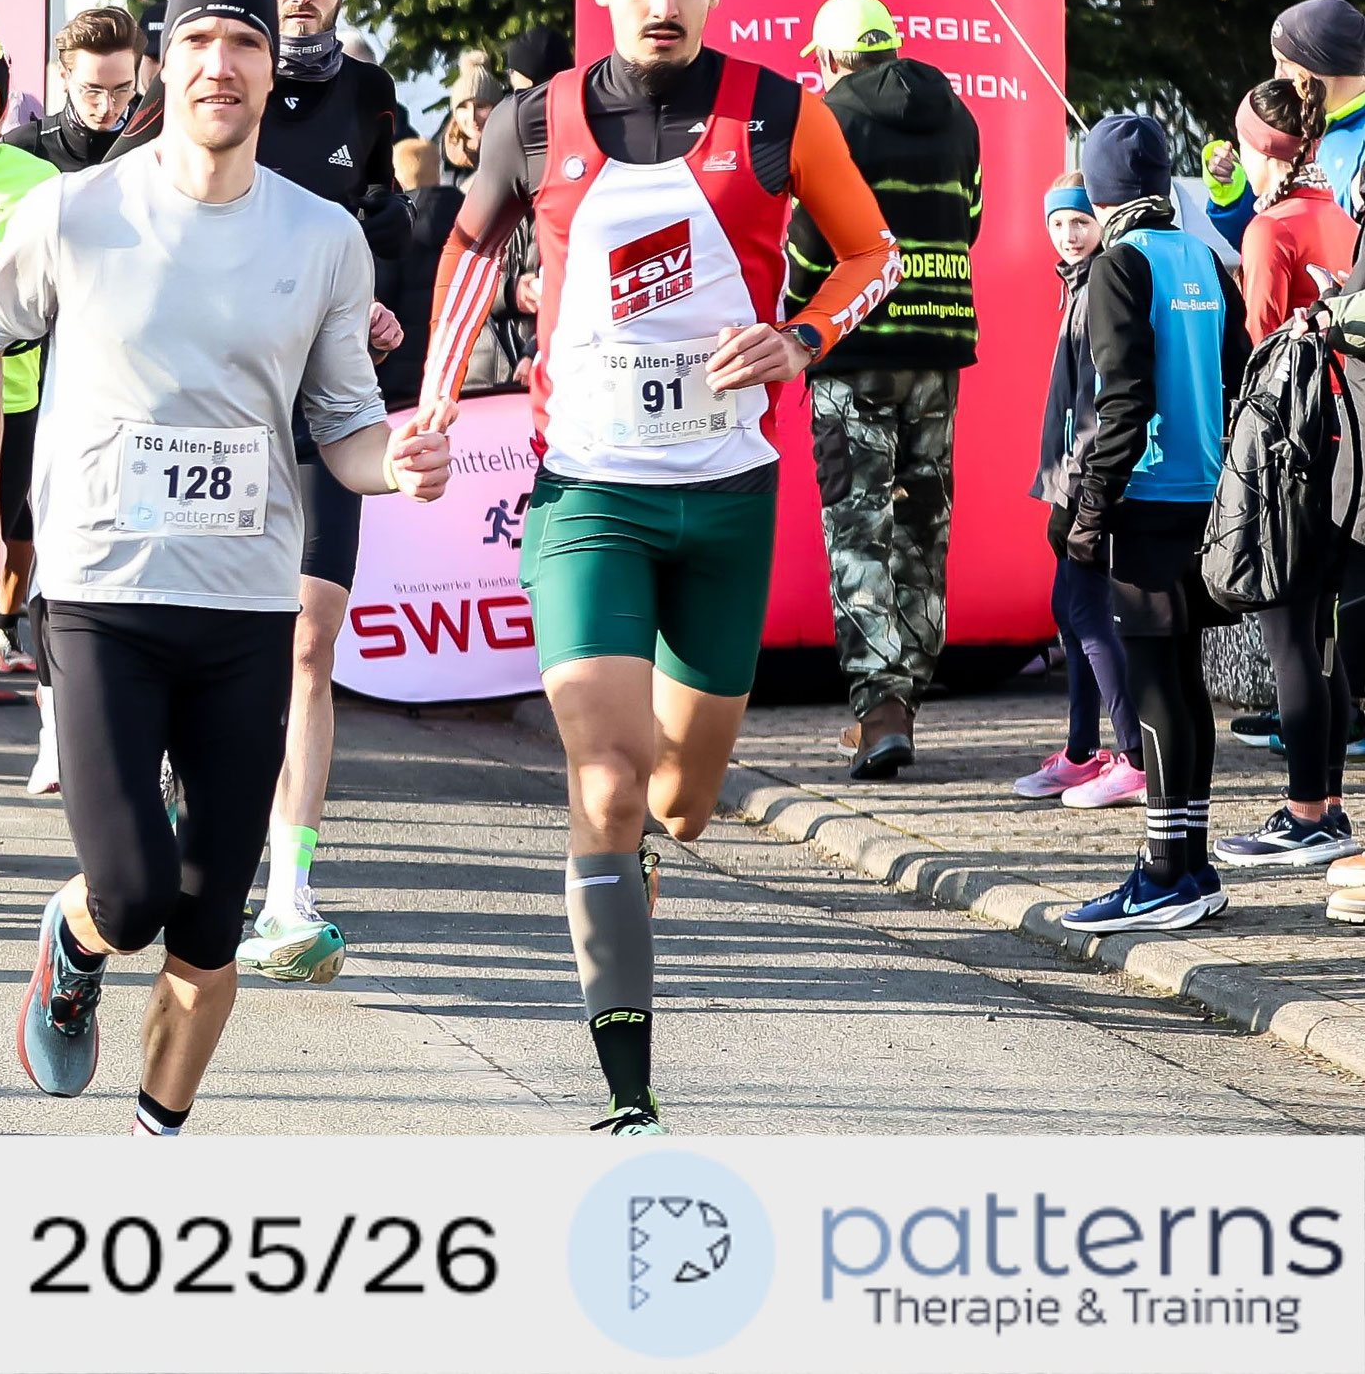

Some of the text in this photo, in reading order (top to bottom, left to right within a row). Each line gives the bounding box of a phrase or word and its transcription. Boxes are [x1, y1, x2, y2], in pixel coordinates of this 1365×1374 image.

[730, 16, 800, 43] MIT
[611, 247, 690, 295] TSV
[1183, 282, 1201, 295] TSG
[642, 377, 684, 413] 91
[637, 417, 707, 437] patterns
[135, 435, 260, 455] TSG Alten-Buseck
[163, 465, 233, 501] 128
[163, 510, 236, 525] patterns
[350, 595, 535, 660] SWG
[595, 1011, 646, 1029] cep
